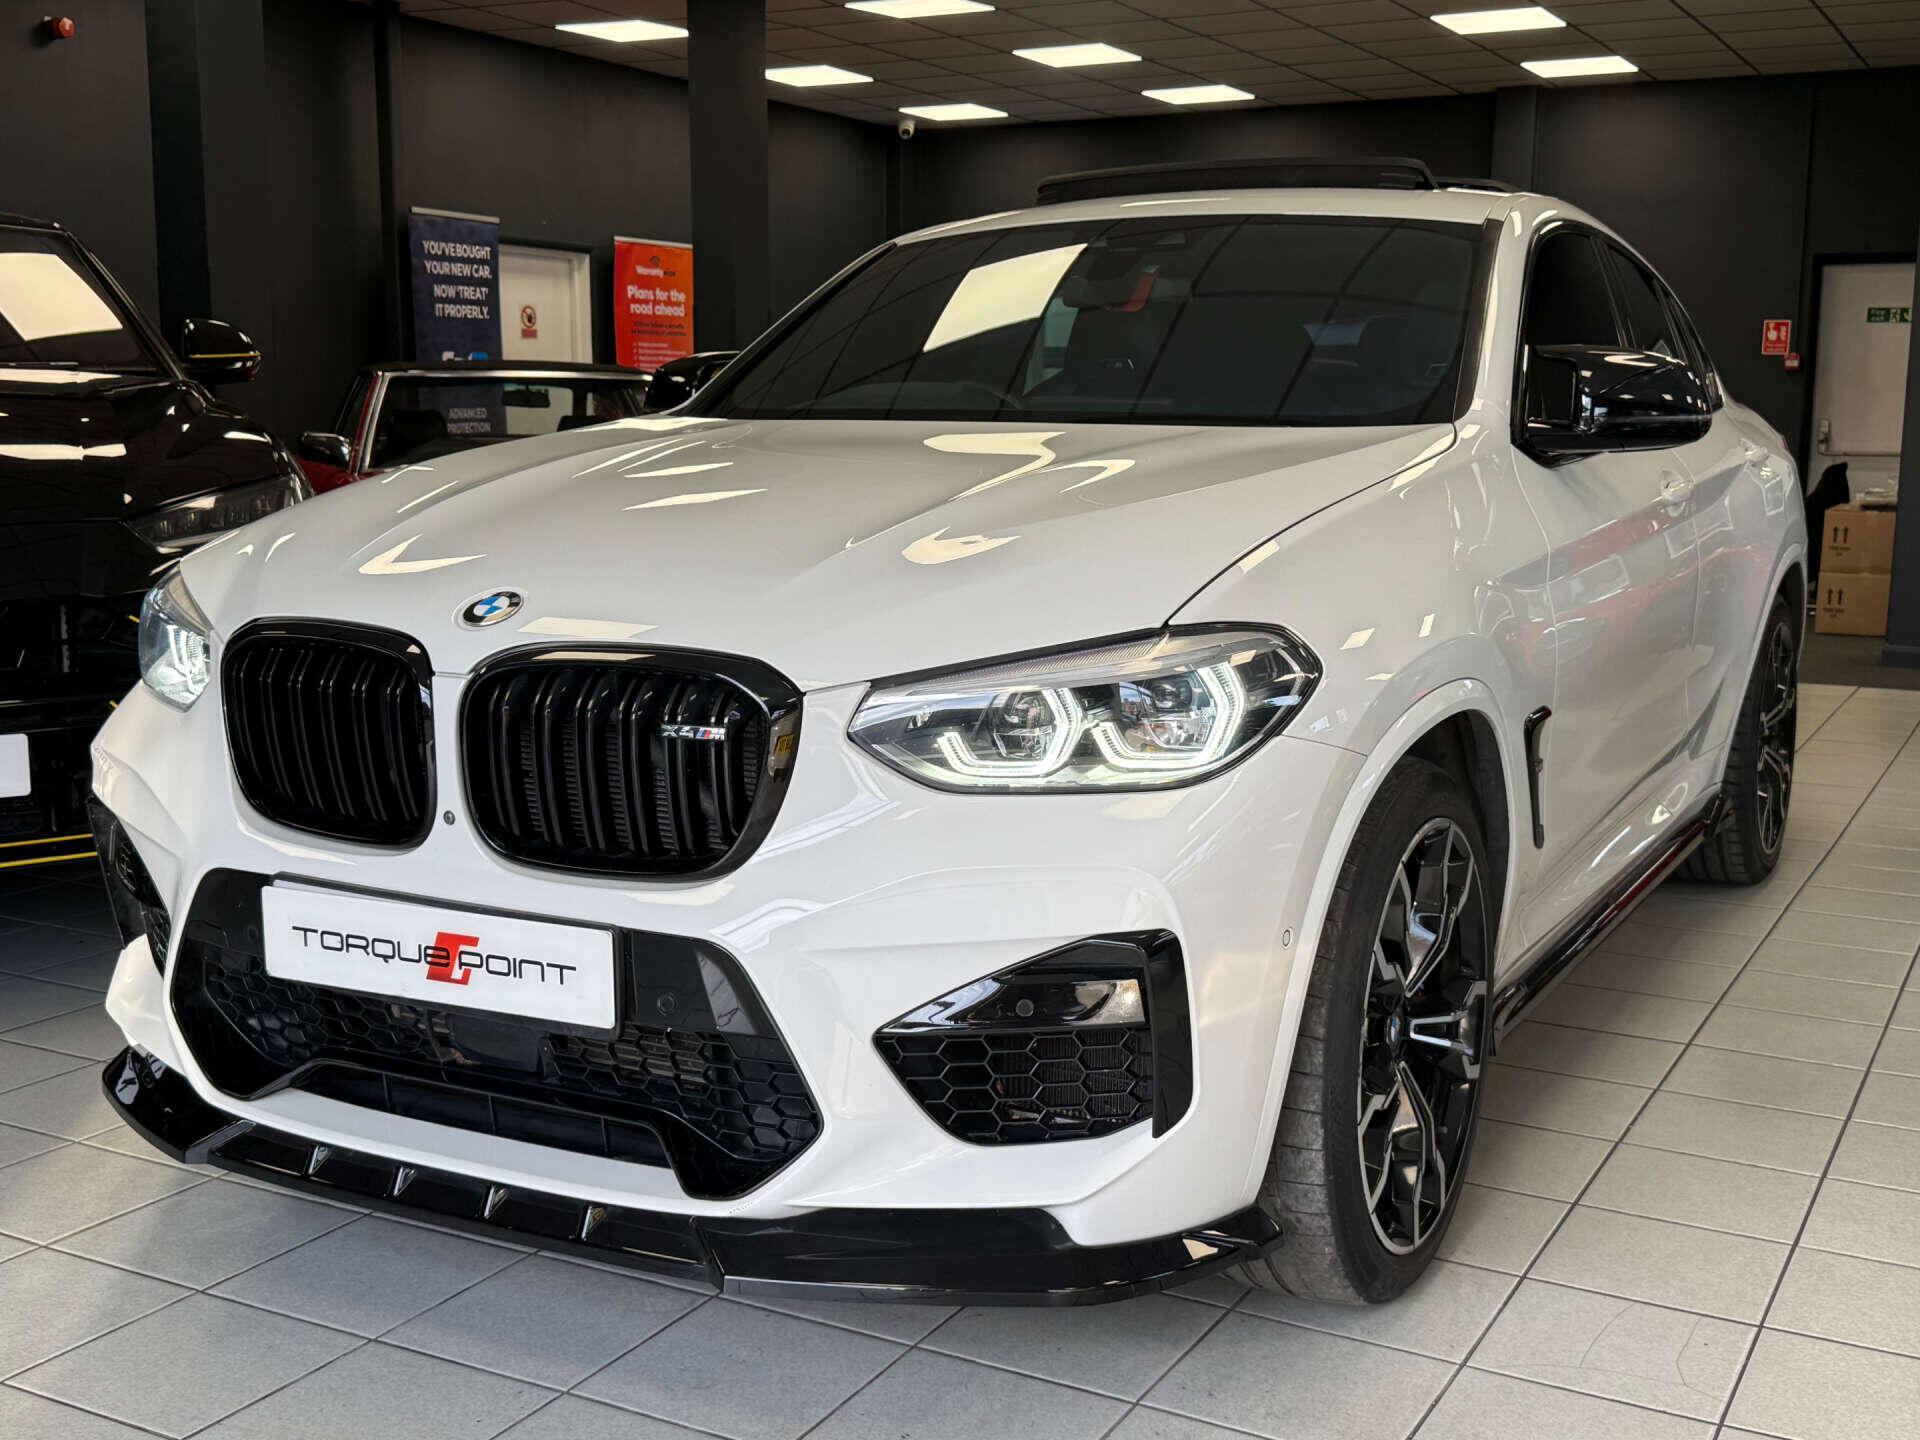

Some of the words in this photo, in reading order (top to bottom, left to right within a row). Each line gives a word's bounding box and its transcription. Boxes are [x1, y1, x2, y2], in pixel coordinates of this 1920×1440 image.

[422, 240, 456, 257] YOU'VE
[456, 243, 492, 260] BOUGHT
[424, 260, 450, 275] YOUR
[451, 262, 472, 277] NEW
[472, 264, 492, 279] CAR.
[433, 284, 457, 299] NOW
[627, 285, 654, 301] Plans
[655, 287, 669, 301] for
[670, 289, 686, 303] the
[435, 303, 444, 317] IT
[444, 304, 490, 320] PROPERLY.
[630, 302, 653, 316] road
[654, 303, 685, 318] ahead
[448, 408, 487, 419] ADVANCED
[447, 422, 491, 434] PROTECTION
[292, 925, 450, 968] TORQUE
[458, 949, 577, 986] POINT
